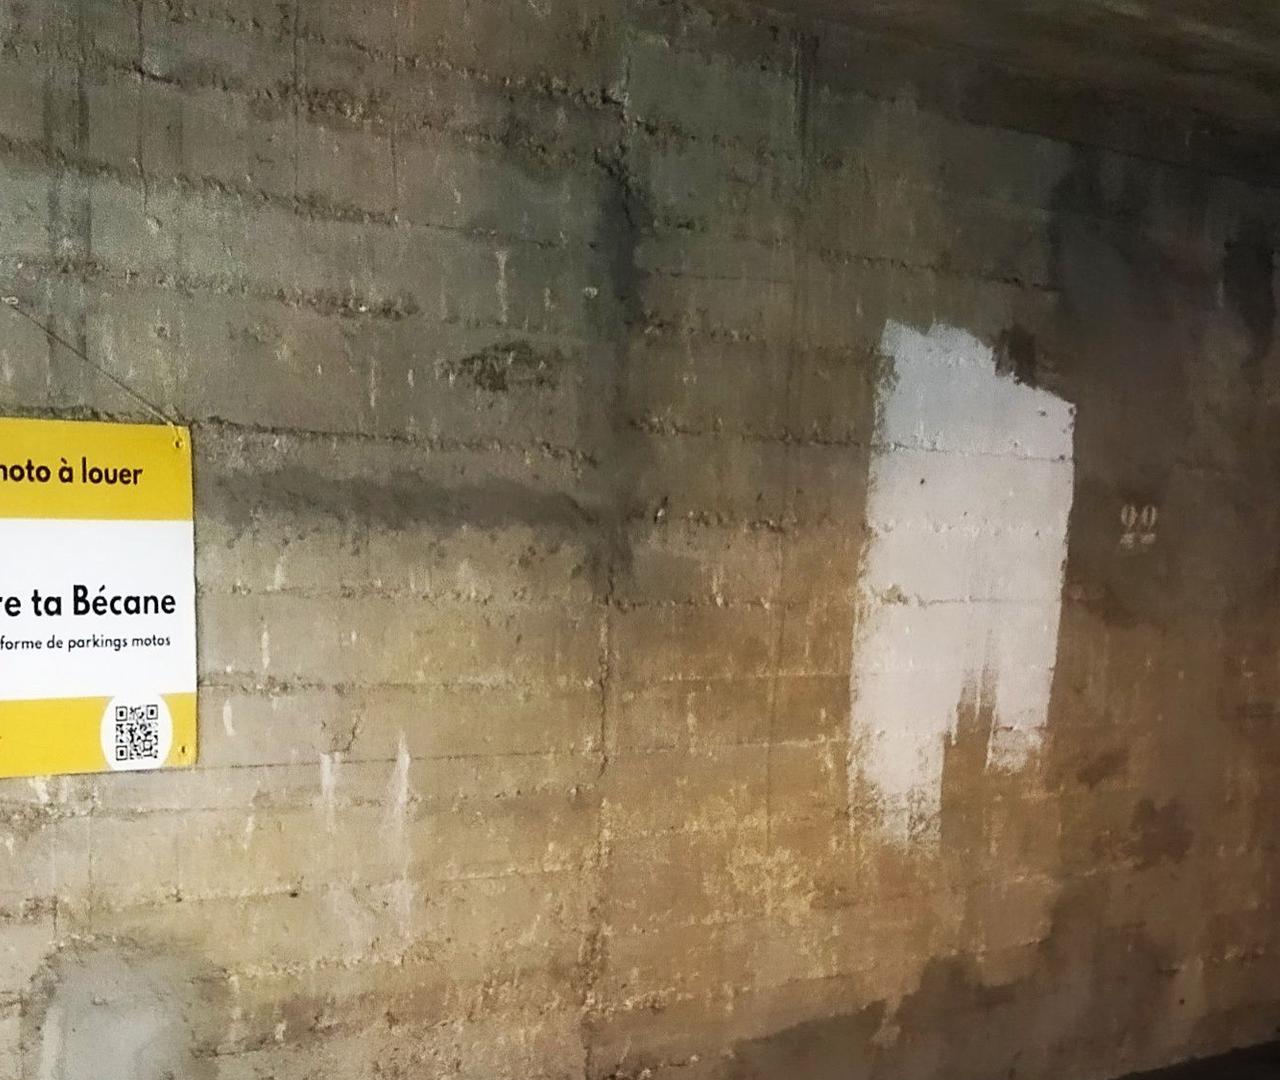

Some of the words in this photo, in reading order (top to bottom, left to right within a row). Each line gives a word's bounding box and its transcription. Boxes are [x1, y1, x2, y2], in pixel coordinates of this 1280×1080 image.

[58, 457, 74, 483] à
[82, 457, 143, 485] louer
[31, 590, 62, 617] ta
[73, 584, 176, 616] Bécane
[47, 635, 63, 650] de
[68, 634, 128, 652] parkings
[132, 634, 171, 647] motos
